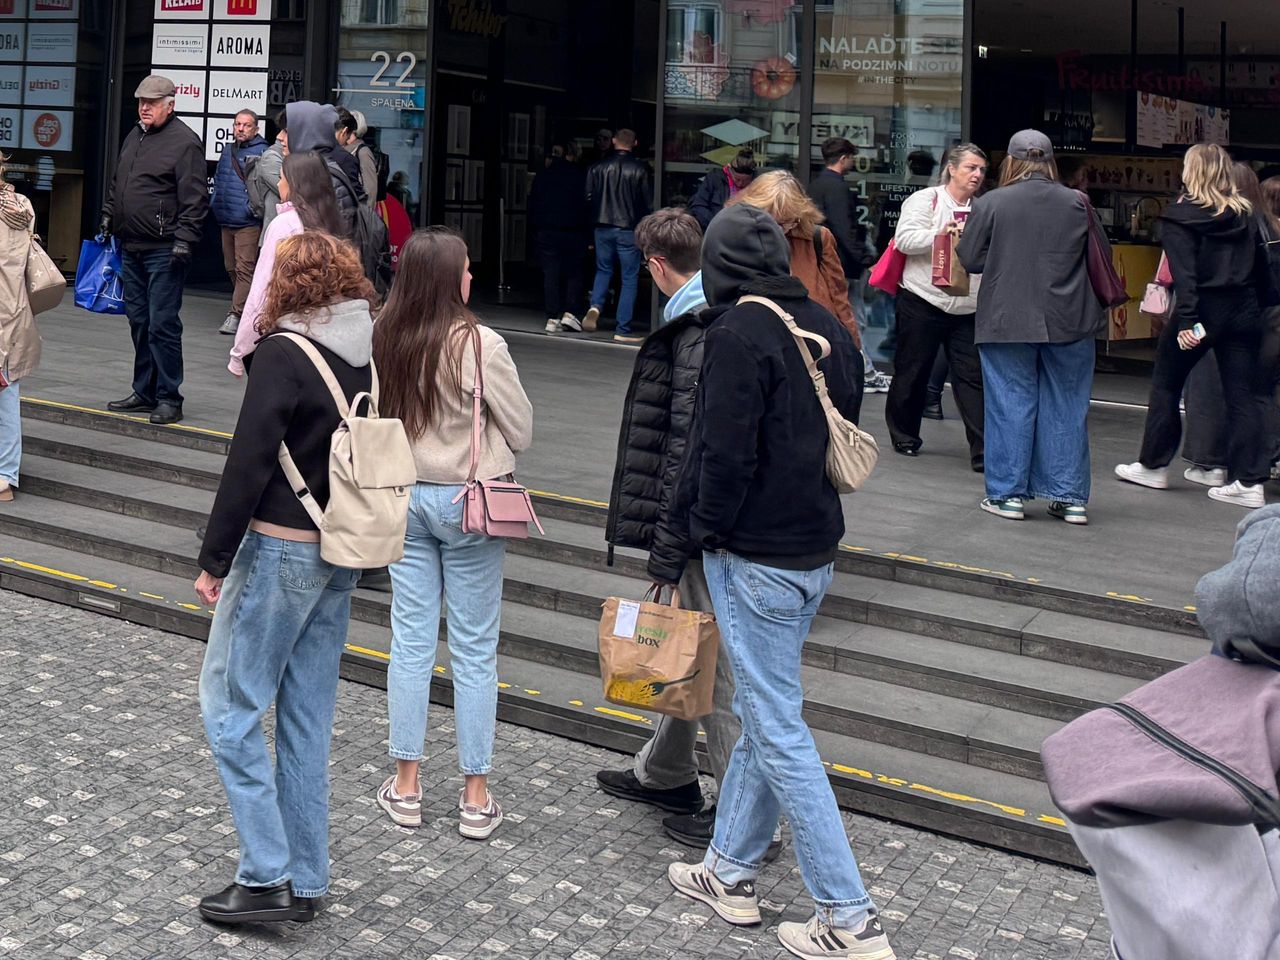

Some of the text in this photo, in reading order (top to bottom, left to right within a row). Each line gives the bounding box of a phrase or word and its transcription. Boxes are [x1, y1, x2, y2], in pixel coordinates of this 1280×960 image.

[216, 37, 263, 55] AROMA
[819, 32, 924, 54] NALAĎTE
[370, 51, 416, 88] 22
[820, 57, 958, 72] NA PODZIMNÍ NOTU
[175, 84, 200, 98] rizly
[212, 89, 263, 100] DELMART
[637, 634, 661, 649] box
